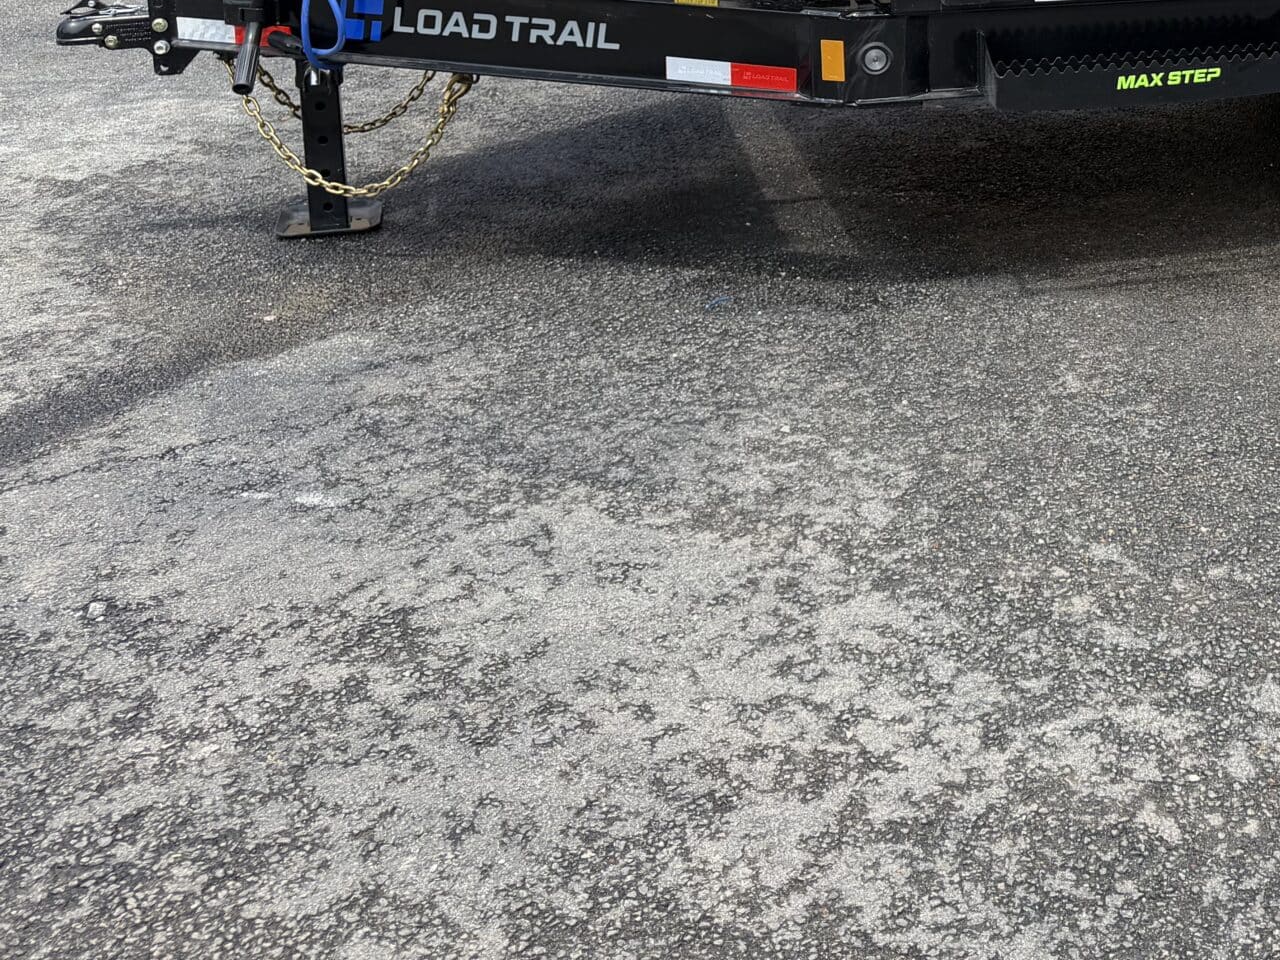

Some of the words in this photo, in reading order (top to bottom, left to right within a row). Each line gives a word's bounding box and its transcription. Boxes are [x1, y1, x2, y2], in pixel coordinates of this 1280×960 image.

[393, 7, 498, 40] LOAD
[504, 15, 620, 50] TRAIL
[1116, 75, 1164, 90] MAX
[1167, 68, 1221, 84] STEP
